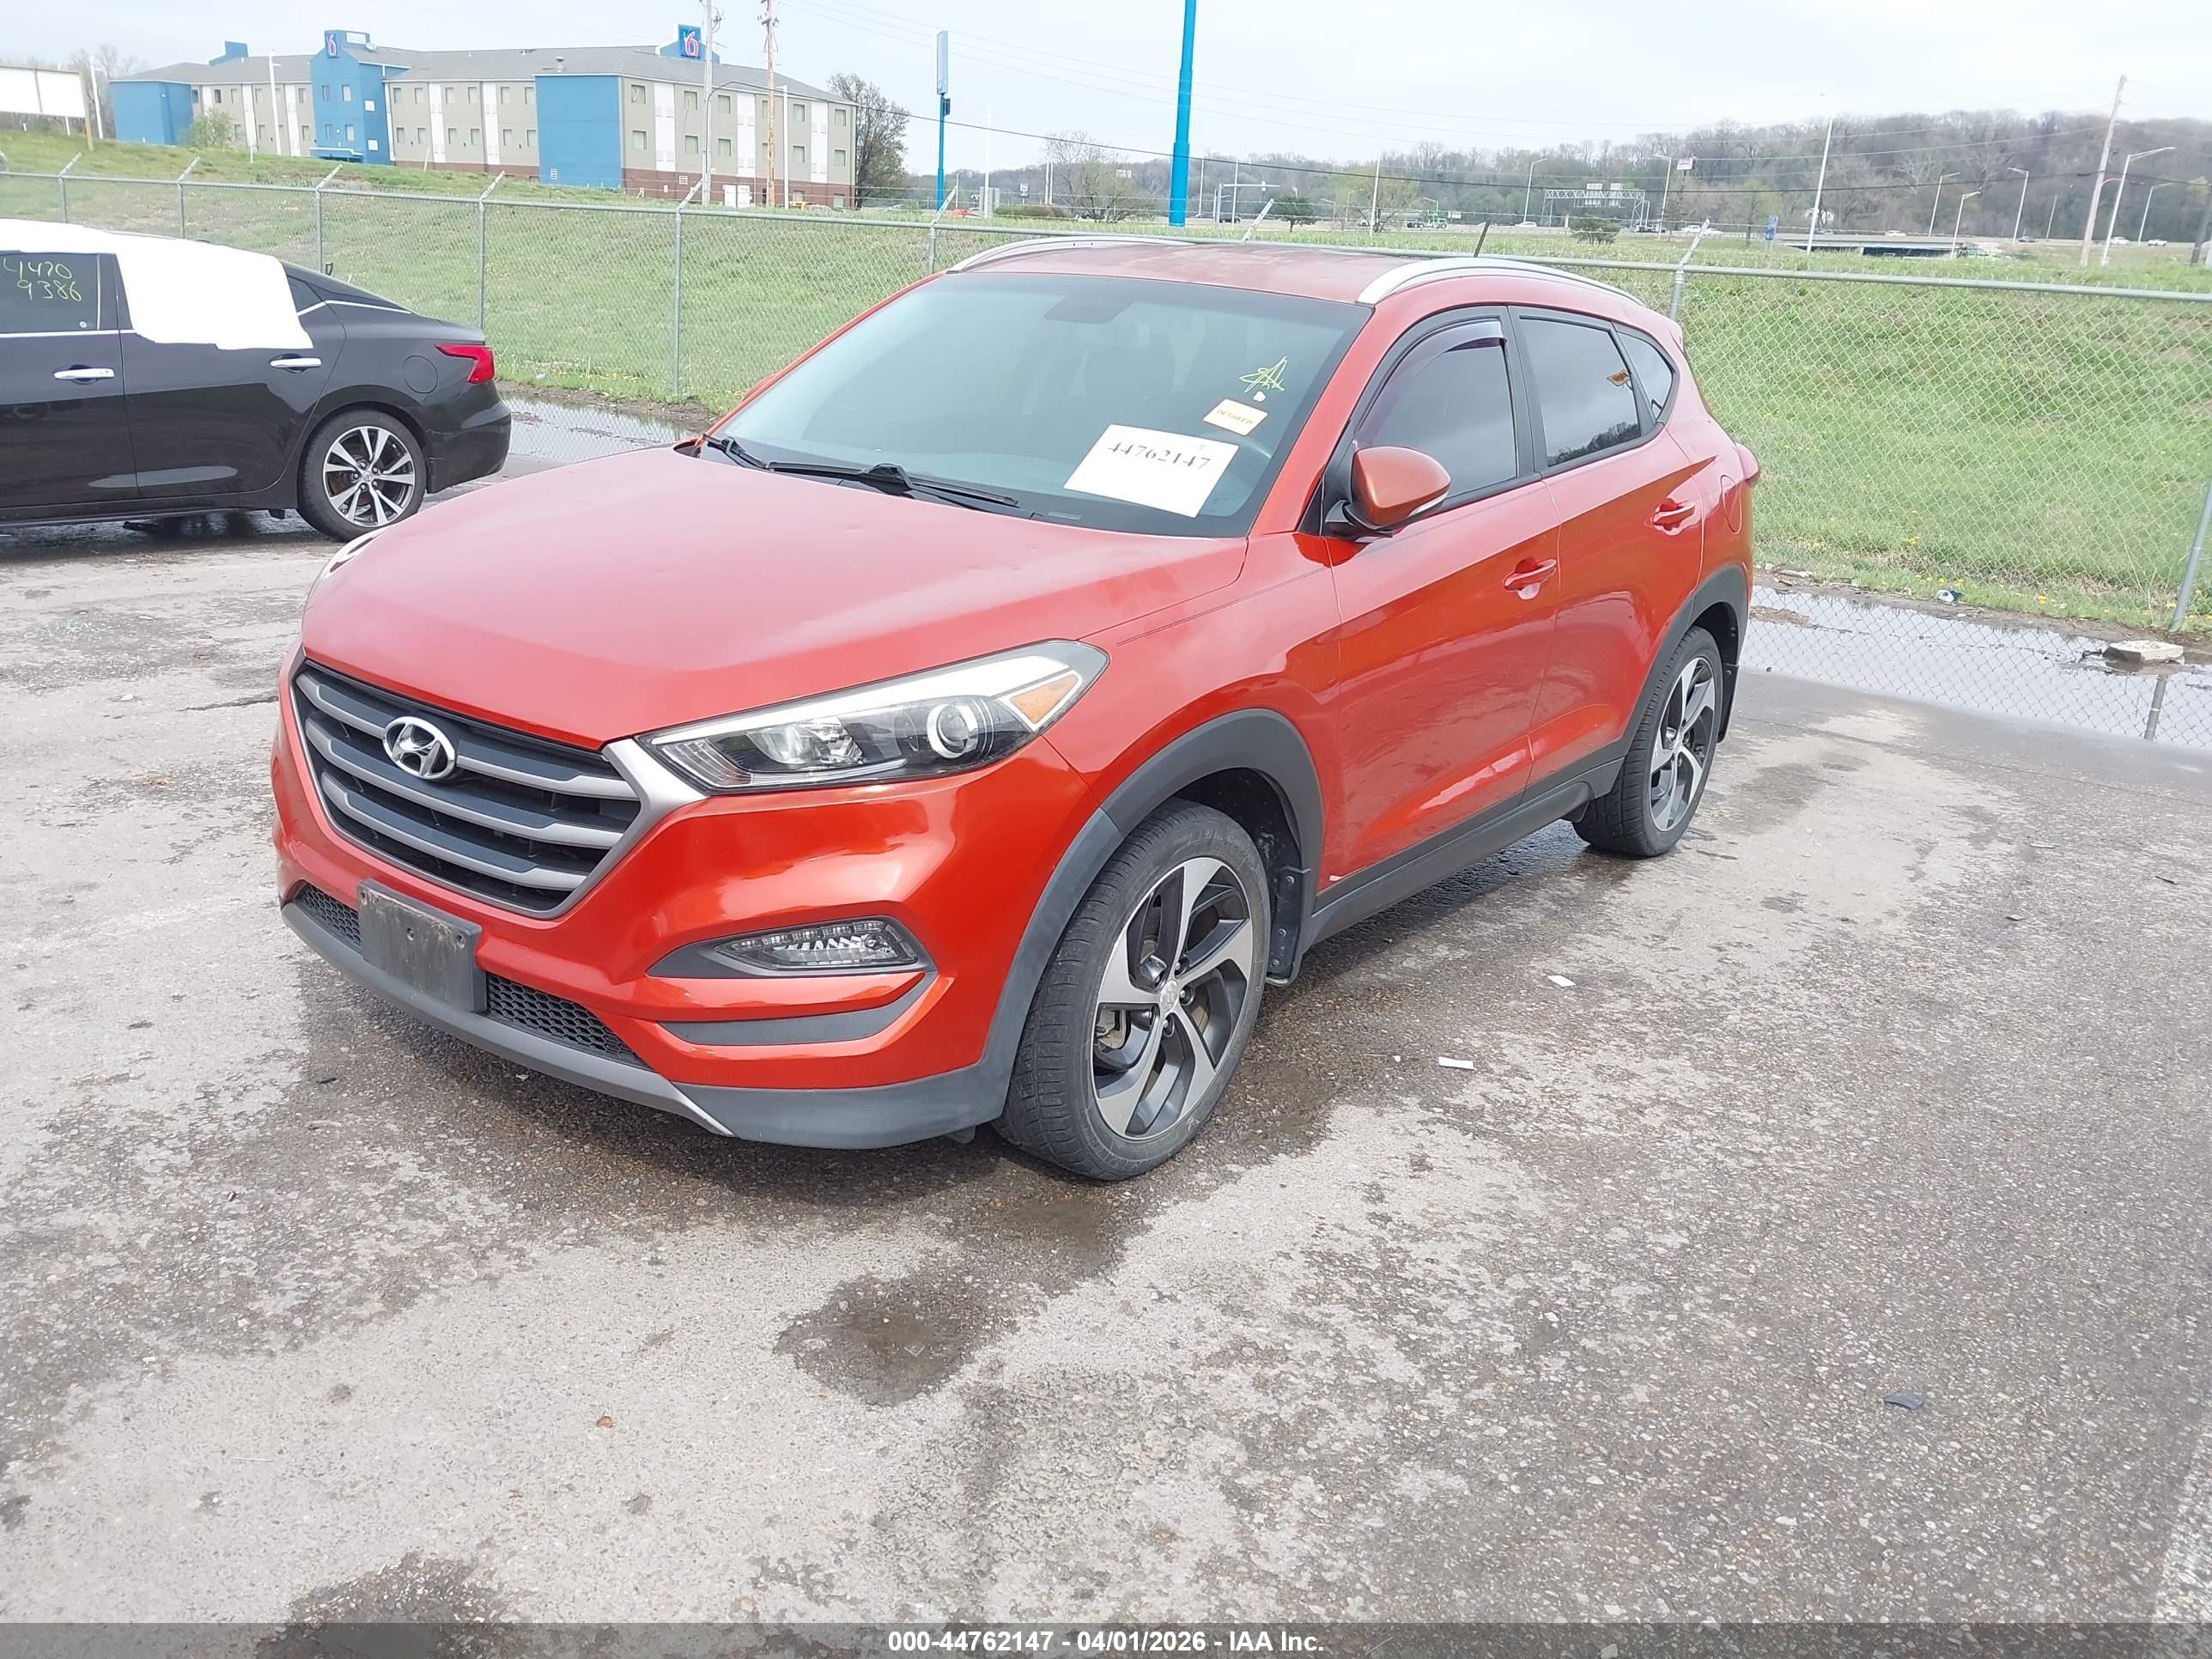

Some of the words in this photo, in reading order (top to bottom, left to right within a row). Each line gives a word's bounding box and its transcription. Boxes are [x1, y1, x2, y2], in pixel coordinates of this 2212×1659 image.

[684, 31, 699, 56] 6
[17, 279, 82, 301] 9386
[1107, 441, 1212, 470] 44762147
